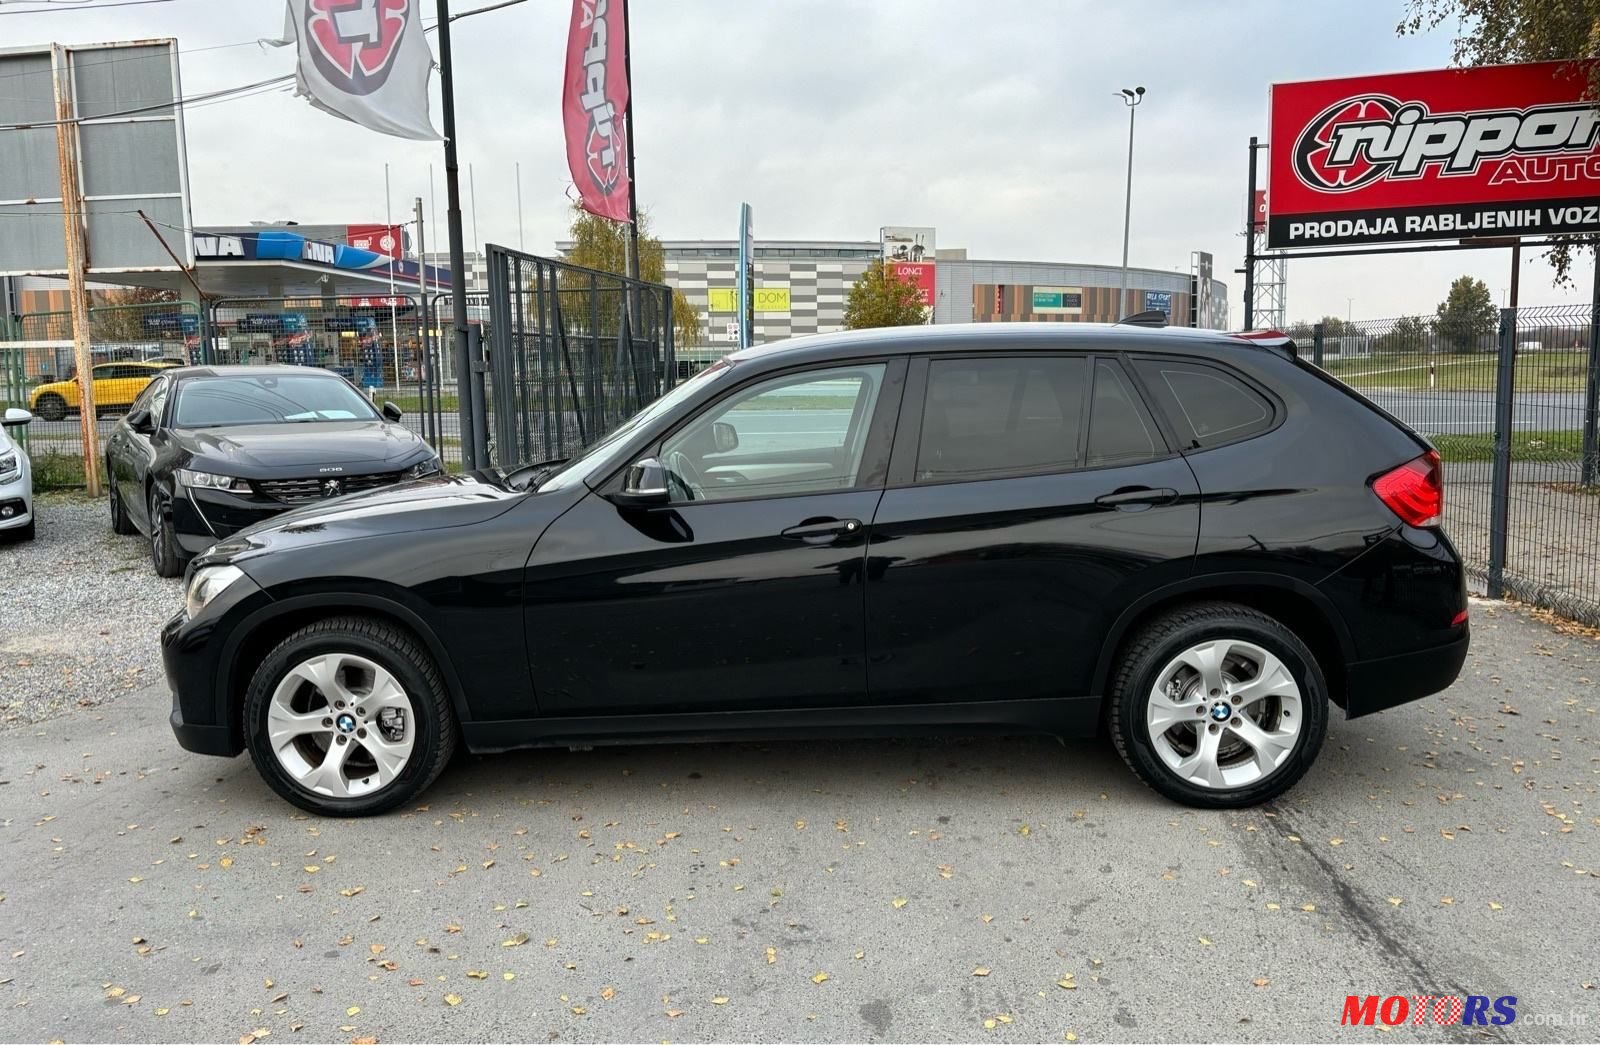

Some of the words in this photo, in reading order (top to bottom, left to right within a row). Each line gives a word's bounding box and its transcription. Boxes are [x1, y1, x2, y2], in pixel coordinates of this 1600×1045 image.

[1289, 219, 1398, 240] PRODAJA
[1405, 208, 1541, 233] RABLJENIH
[1548, 206, 1600, 225] VOZ
[194, 236, 245, 256] NA
[302, 241, 335, 264] INA
[758, 292, 787, 304] DOM
